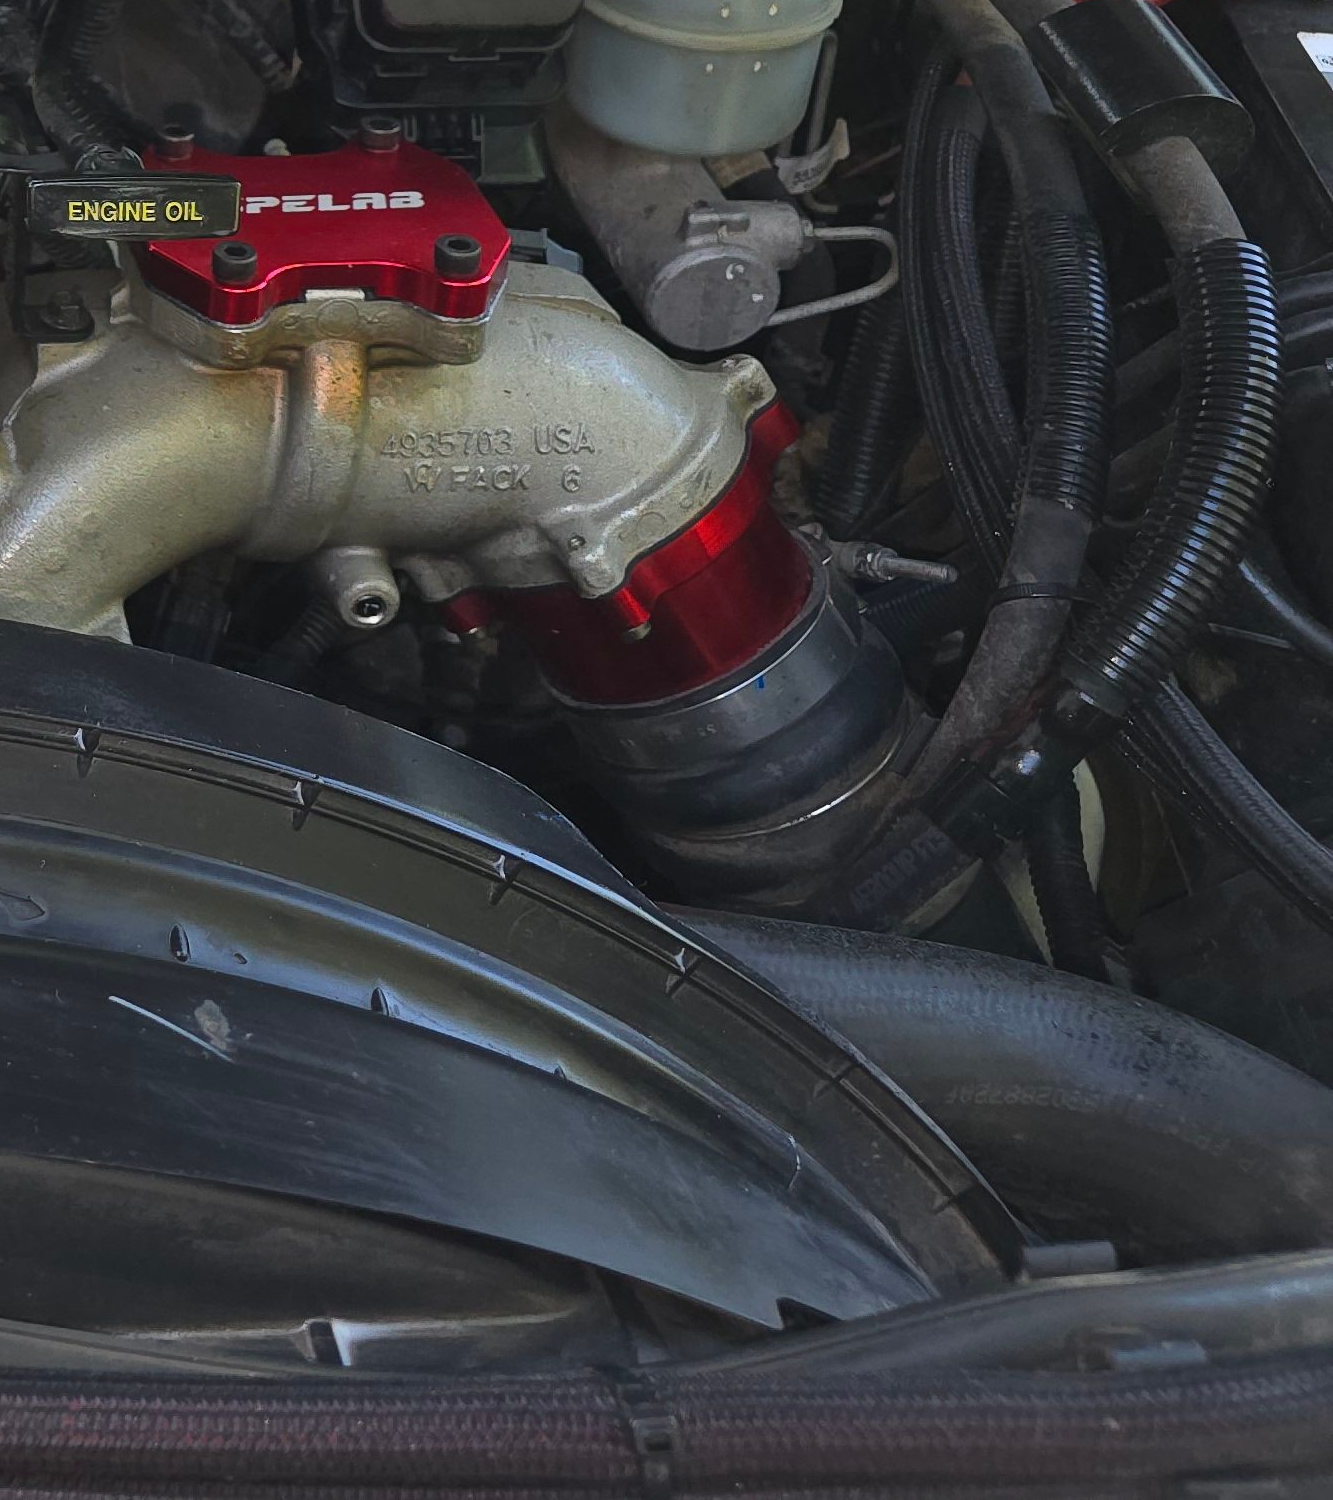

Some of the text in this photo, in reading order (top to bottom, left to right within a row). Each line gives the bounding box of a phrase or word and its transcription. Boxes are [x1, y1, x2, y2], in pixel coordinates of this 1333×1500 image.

[67, 201, 203, 222] ENGINE OIL
[240, 190, 426, 214] PELAB
[533, 421, 596, 455] USA
